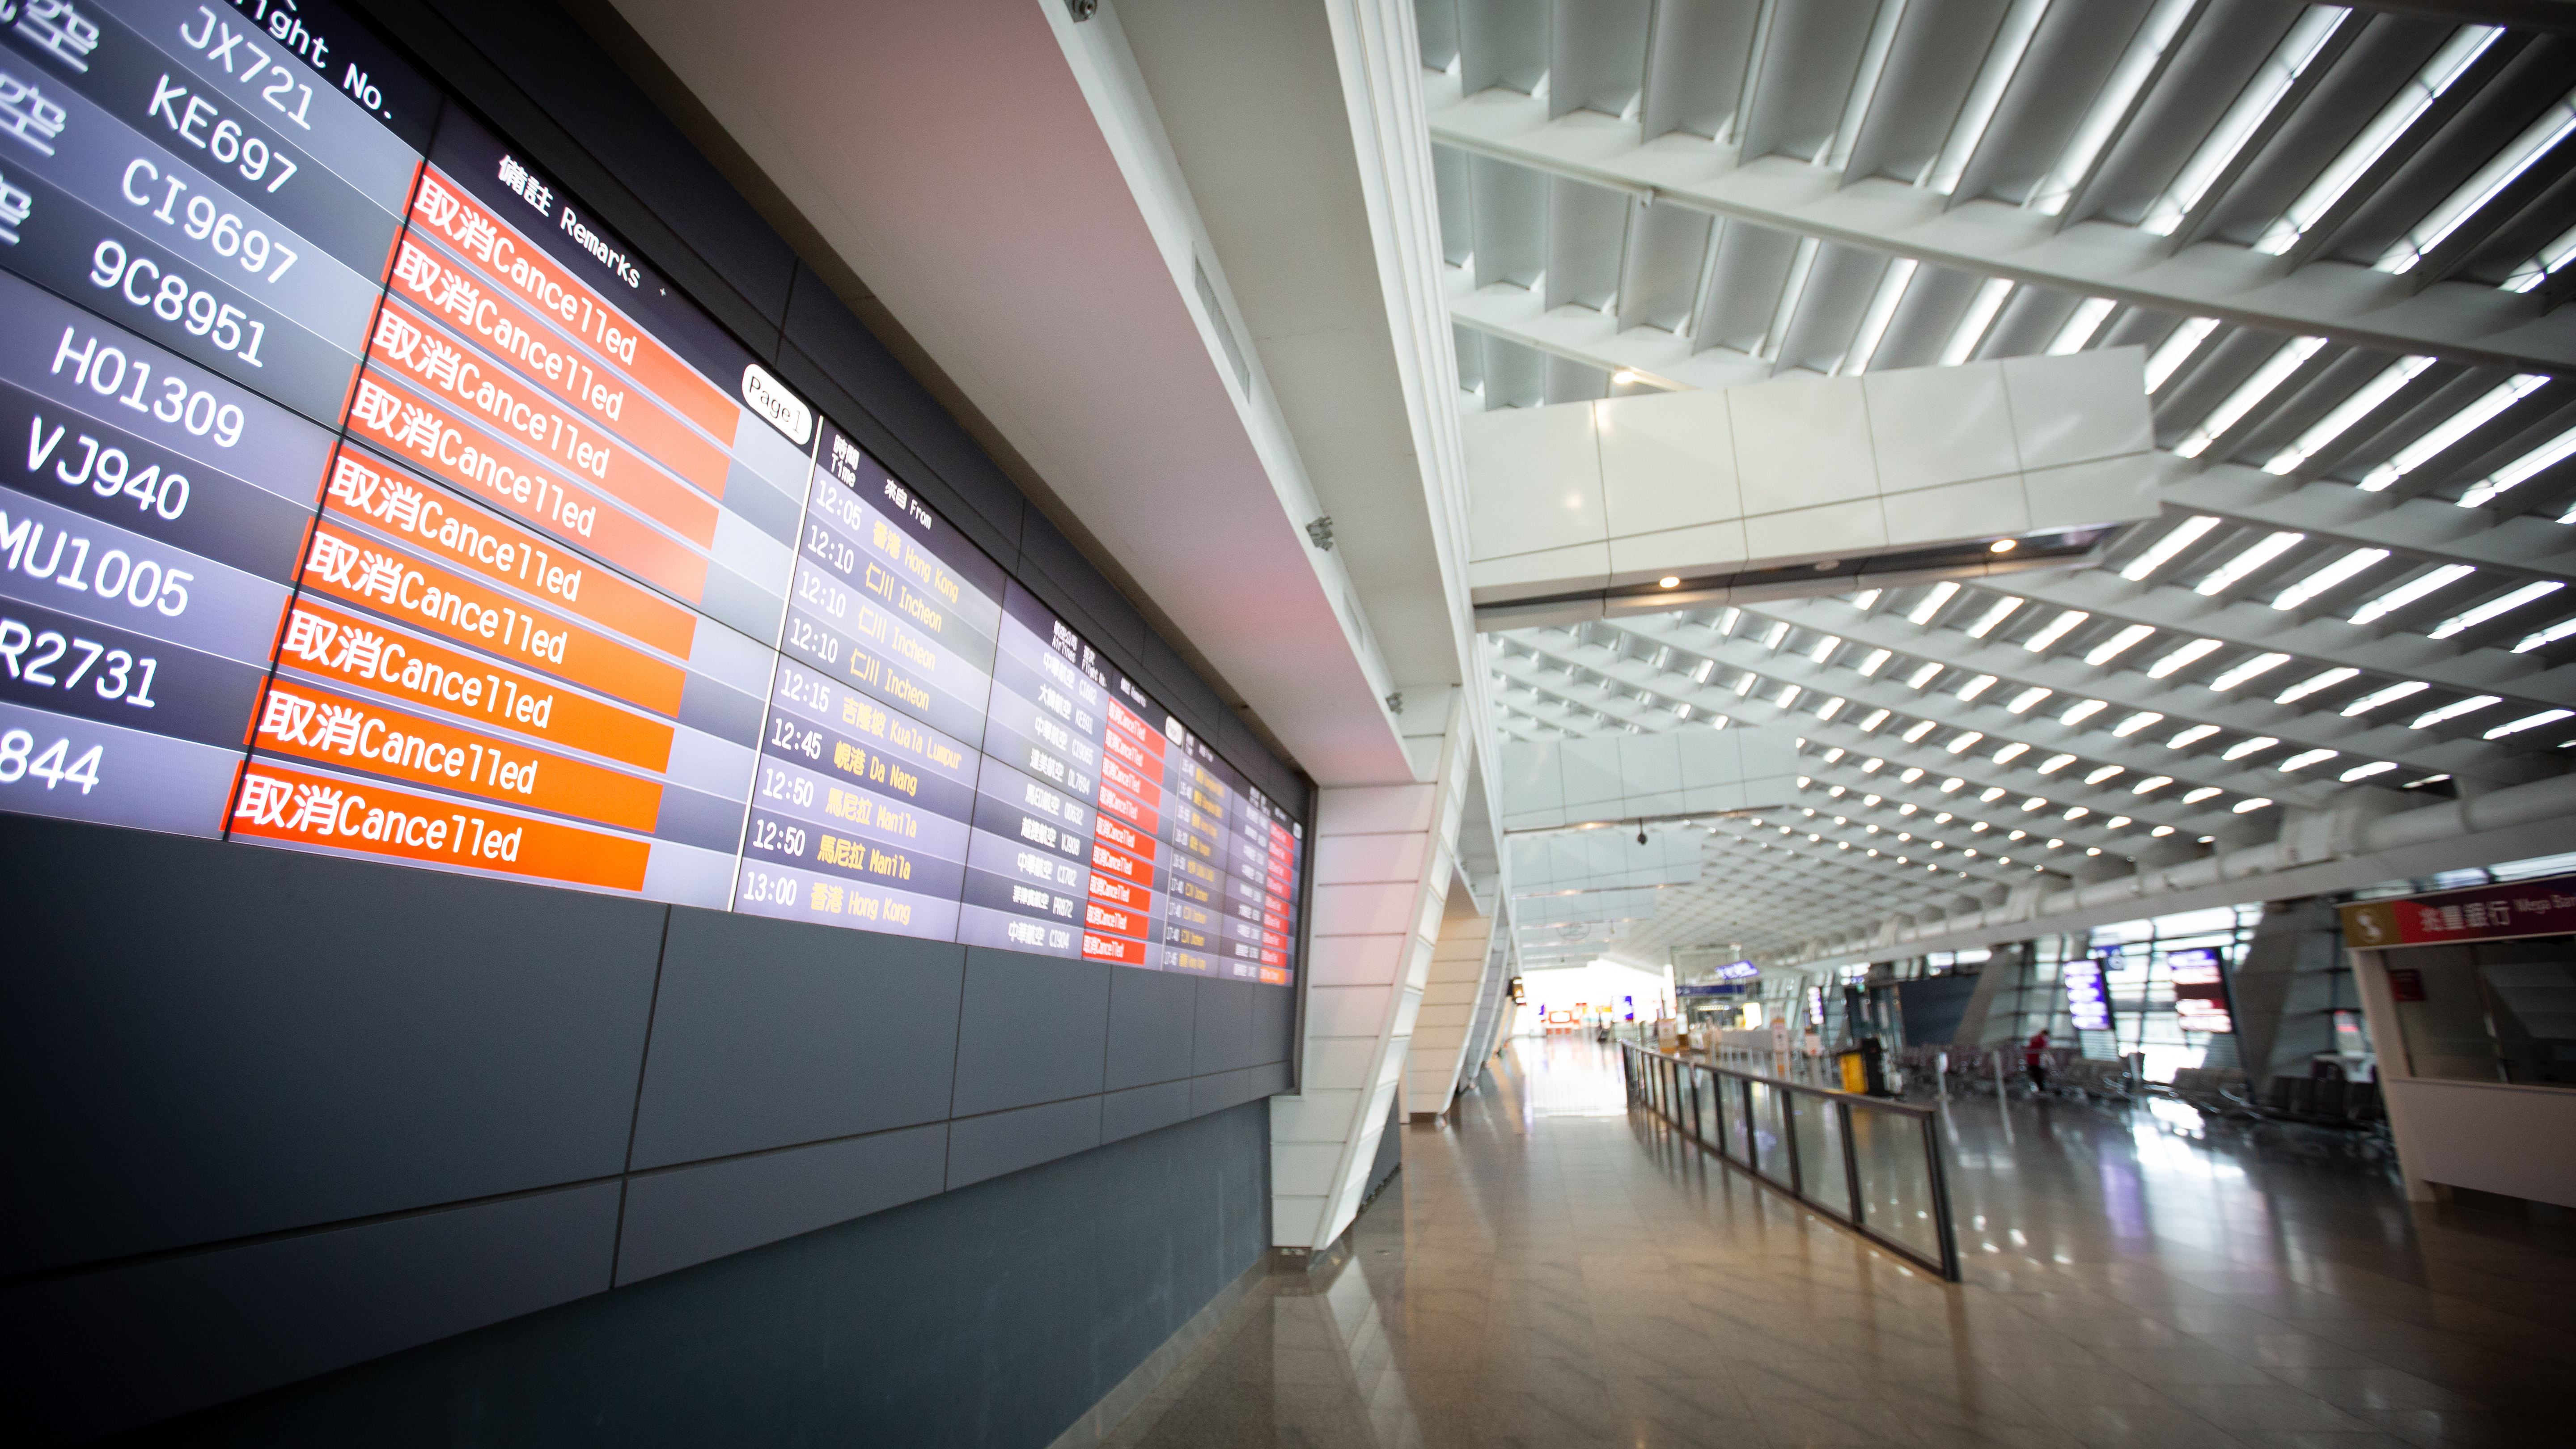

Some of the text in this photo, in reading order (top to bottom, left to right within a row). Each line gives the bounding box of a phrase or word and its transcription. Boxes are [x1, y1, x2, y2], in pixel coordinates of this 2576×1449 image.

[181, 6, 313, 131] JX721
[343, 63, 392, 119] No.
[148, 74, 297, 193] KE697
[122, 158, 299, 284] CI9697
[498, 154, 641, 289] 備註 Remarks
[94, 240, 265, 369] 9C8951
[28, 416, 190, 521] VJ940
[830, 453, 856, 488] Time
[833, 434, 860, 470] 時間
[816, 479, 958, 604] 12:05 香港 Hong Kong
[884, 479, 932, 530] 來自 From
[799, 571, 936, 671] 12:10 仁川 Incheon
[808, 525, 942, 632] 12:10 仁川 Incheon
[790, 618, 930, 710] 12:10 仁川 Incheon
[1052, 635, 1076, 664] Airlines
[1081, 658, 1099, 682] Flight
[771, 718, 822, 759] 12:45
[869, 758, 886, 782] Da
[890, 766, 917, 796] Nang
[780, 669, 830, 712] 12:15
[890, 720, 923, 753] Kuala
[927, 738, 962, 771] Lumpur
[763, 768, 917, 838] 12:50 馬尼拉 Manila
[752, 819, 911, 880] 12:50 馬尼拉 Manila
[743, 872, 911, 925] 13:00 香港 Hong Kong
